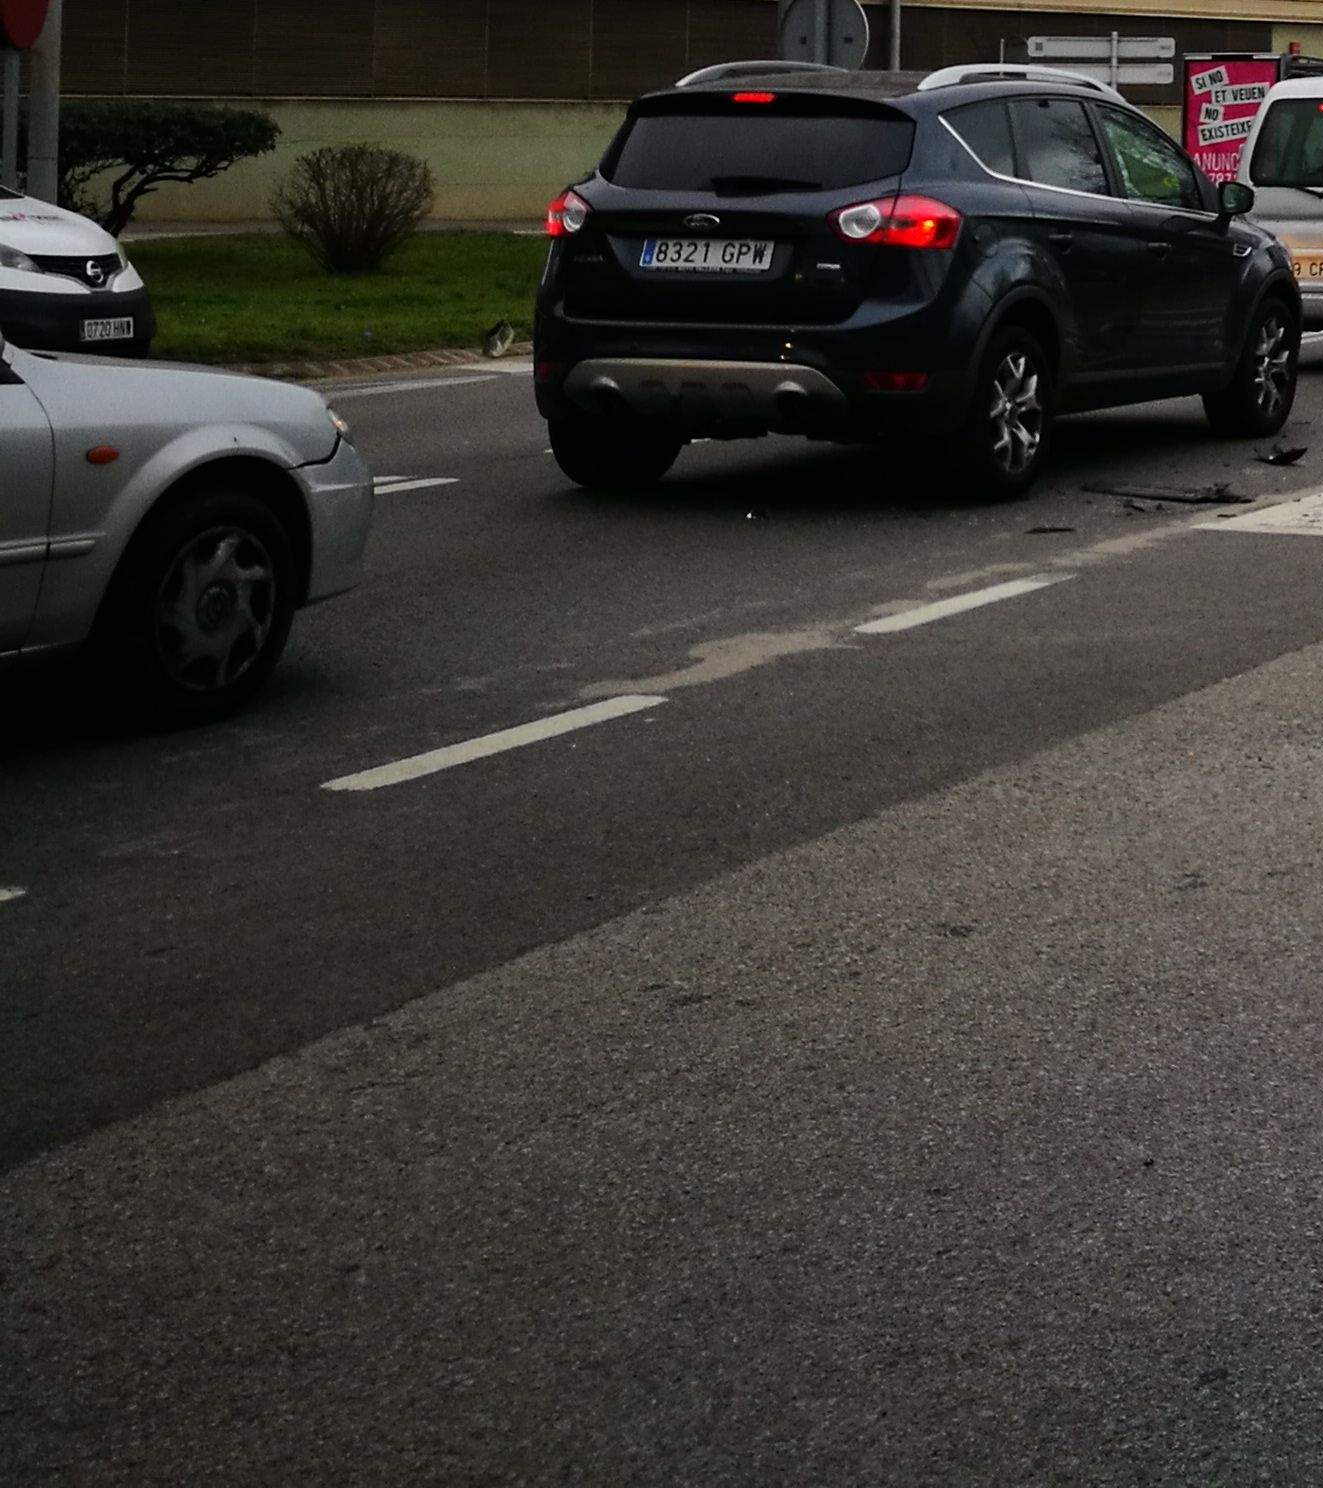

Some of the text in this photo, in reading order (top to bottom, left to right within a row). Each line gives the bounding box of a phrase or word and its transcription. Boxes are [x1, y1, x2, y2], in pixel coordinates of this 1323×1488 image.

[1195, 70, 1223, 90] SI NO
[1214, 86, 1265, 104] ET VEUEN
[1204, 107, 1219, 120] NO
[655, 242, 767, 263] 8321 GPW
